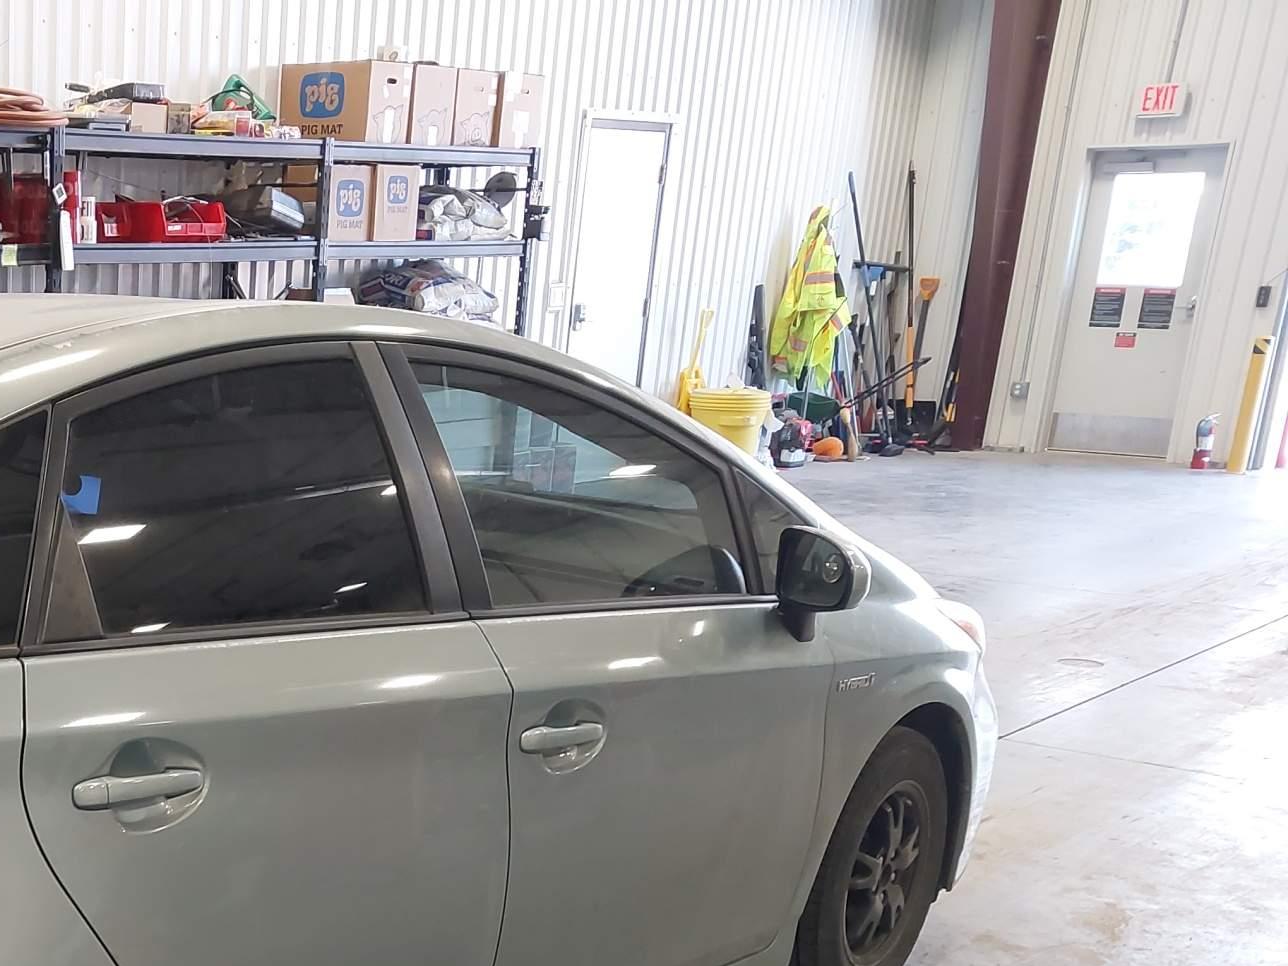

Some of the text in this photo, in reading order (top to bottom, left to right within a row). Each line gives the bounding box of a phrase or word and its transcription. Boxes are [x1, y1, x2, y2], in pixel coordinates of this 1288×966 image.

[305, 78, 339, 112] pig
[1142, 85, 1178, 111] EXIT
[301, 124, 343, 135] PIG MAT
[339, 184, 360, 211] pig
[389, 179, 407, 201] pig
[336, 220, 362, 229] PIG MAT
